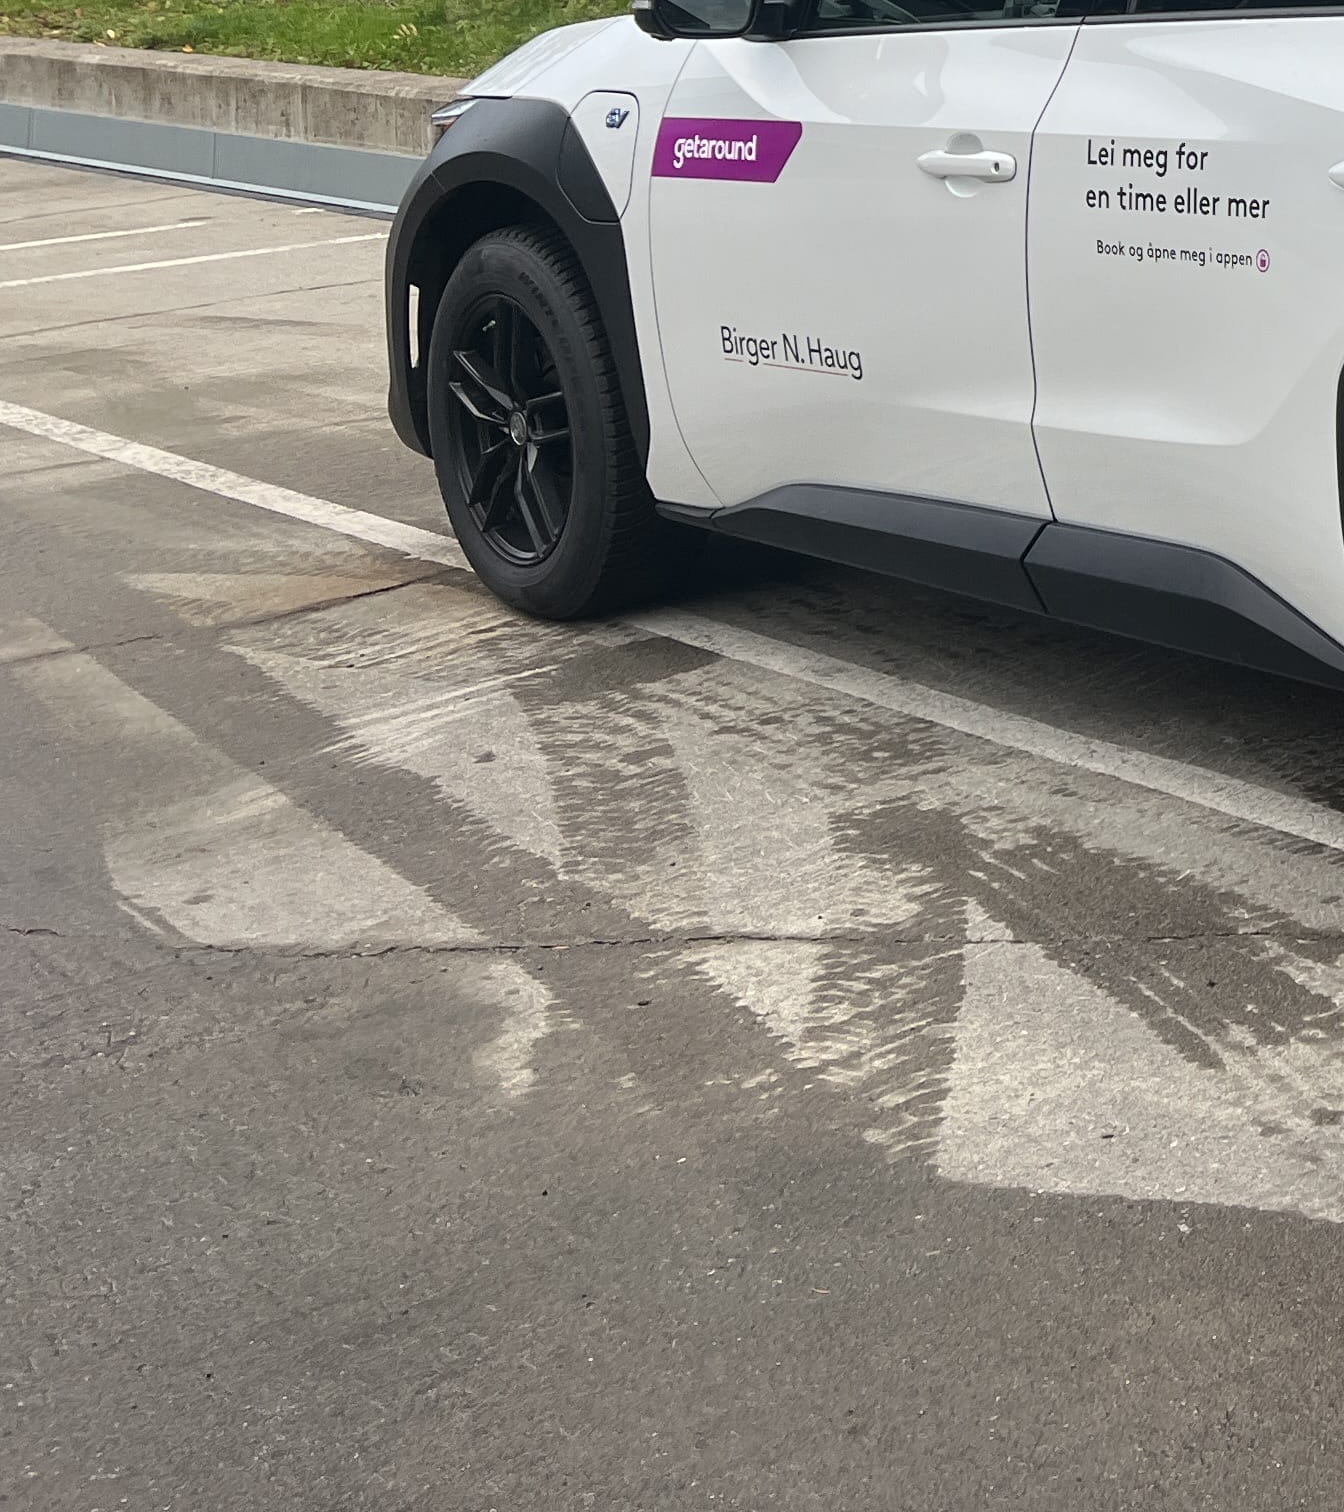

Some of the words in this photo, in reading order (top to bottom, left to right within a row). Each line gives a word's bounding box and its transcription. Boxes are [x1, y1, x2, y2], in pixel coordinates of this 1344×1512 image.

[673, 134, 758, 169] getaround
[1087, 138, 1115, 166] Lei
[1122, 147, 1168, 178] meg
[1175, 142, 1209, 171] for
[1085, 189, 1110, 209] en
[1116, 182, 1167, 213] time
[1173, 186, 1220, 216] eller
[1227, 197, 1270, 219] mer
[1096, 239, 1126, 257] Book
[1128, 245, 1144, 262] og
[1147, 242, 1177, 263] åpne
[1180, 248, 1206, 267] meg
[1208, 246, 1214, 263] i
[1216, 251, 1253, 269] appen
[720, 325, 778, 367] Birger
